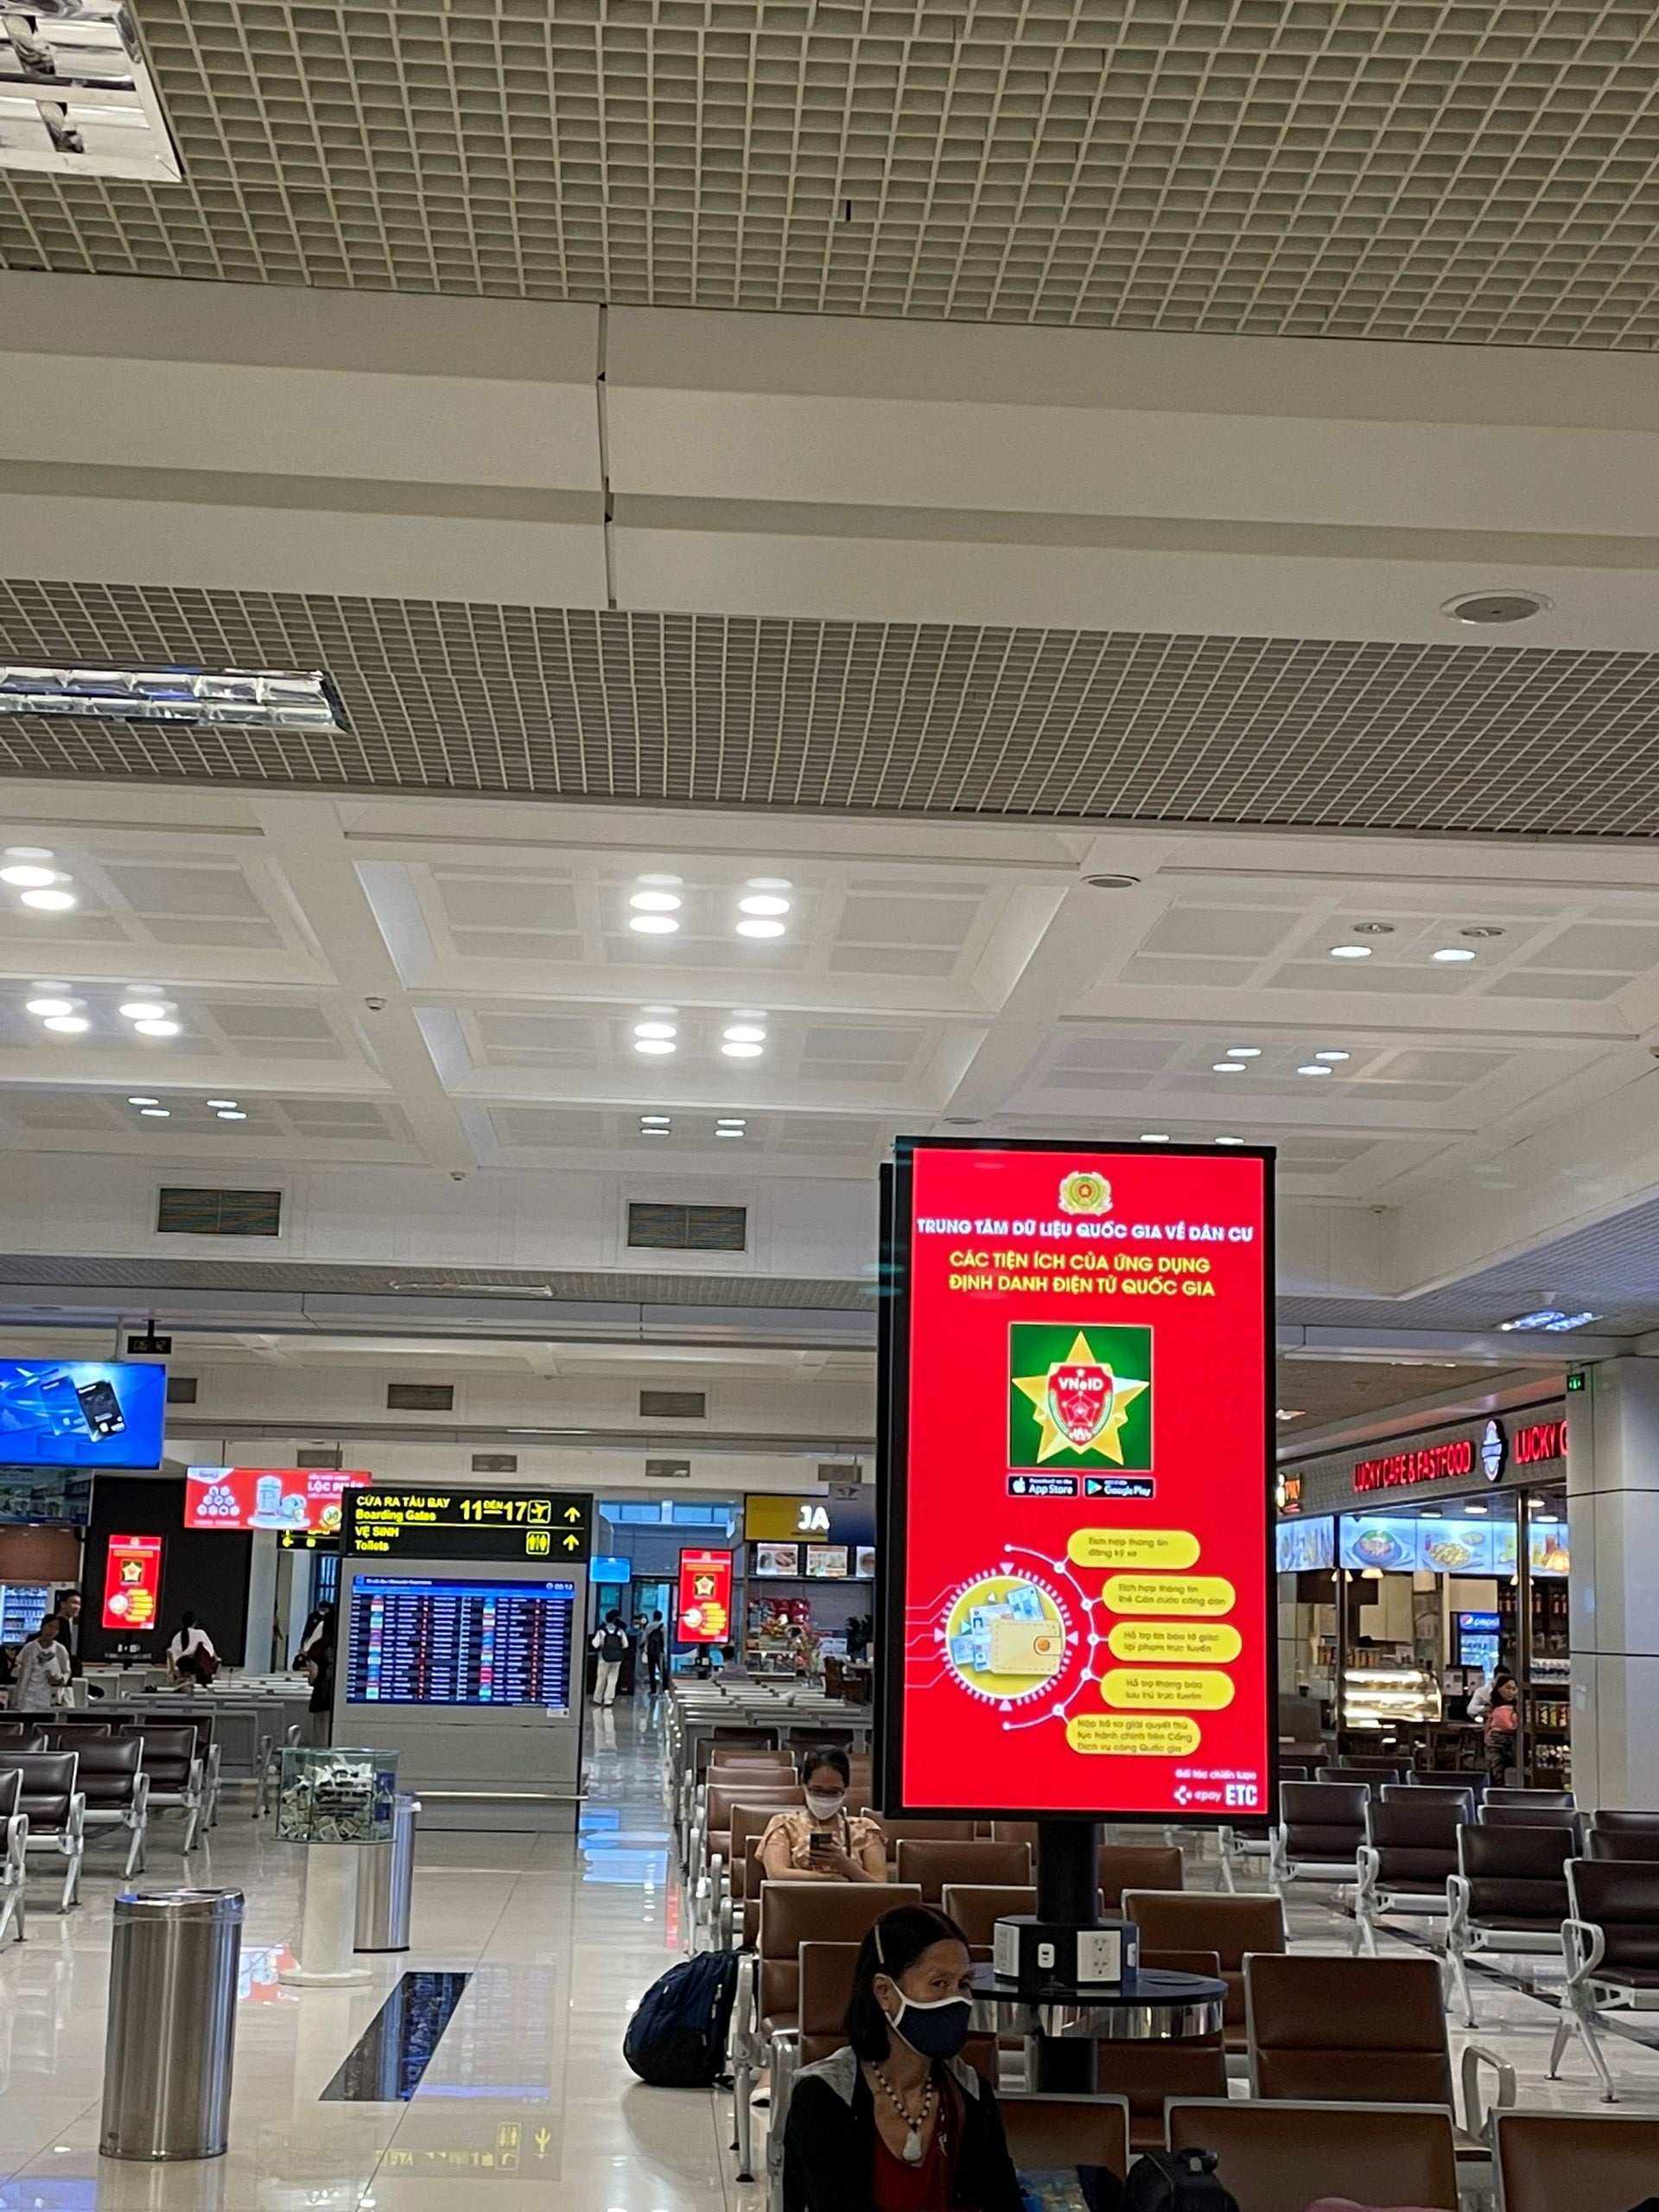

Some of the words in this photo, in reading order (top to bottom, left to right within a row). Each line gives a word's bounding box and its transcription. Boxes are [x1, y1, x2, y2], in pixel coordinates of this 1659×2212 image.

[917, 1218, 972, 1234] TRUNG
[975, 1218, 1008, 1235] TÂM
[1012, 1219, 1037, 1236] DỮ
[1039, 1220, 1072, 1239] LIỆU
[1076, 1220, 1128, 1237] QUỐC
[1131, 1224, 1163, 1239] GIA
[1189, 1224, 1224, 1241] DÂN
[1228, 1226, 1254, 1243] CƯ
[950, 1249, 989, 1268] CÁC
[993, 1250, 1028, 1270] TIỆN
[1034, 1250, 1065, 1269] ÍCH
[1070, 1250, 1109, 1270] CỦA
[1114, 1253, 1154, 1272] ỨNG
[1158, 1256, 1211, 1275] DỤNG
[949, 1274, 993, 1293] ĐỊNH
[998, 1276, 1048, 1292] DANH
[1052, 1275, 1092, 1294] ĐIỆN
[1096, 1274, 1117, 1294] TỬ
[1122, 1275, 1178, 1295] QUỐC
[1182, 1281, 1216, 1297] GIA
[1058, 1377, 1103, 1391] VNeID
[1516, 1426, 1555, 1465] LUCKY
[1353, 1458, 1382, 1492] LUCKY
[1382, 1453, 1407, 1486] CAFE
[1417, 1440, 1471, 1480] FASTFOOD
[1028, 1484, 1048, 1496] App
[1049, 1484, 1073, 1495] Store
[1103, 1485, 1133, 1497] Google
[1134, 1485, 1151, 1497] Play
[355, 1509, 404, 1522] Boarding
[405, 1510, 436, 1521] Gates
[356, 1494, 382, 1506] CỬA
[384, 1496, 401, 1507] RA
[402, 1495, 425, 1508] TÀU
[427, 1497, 450, 1508] BAY
[460, 1500, 482, 1521] 11
[504, 1501, 527, 1521] 17
[354, 1525, 371, 1539] VỆ
[372, 1526, 399, 1537] SINH
[355, 1540, 390, 1551] Toilets
[1474, 1617, 1500, 1626] pepsi
[1194, 1790, 1222, 1802] epay
[1225, 1783, 1257, 1806] ETC
